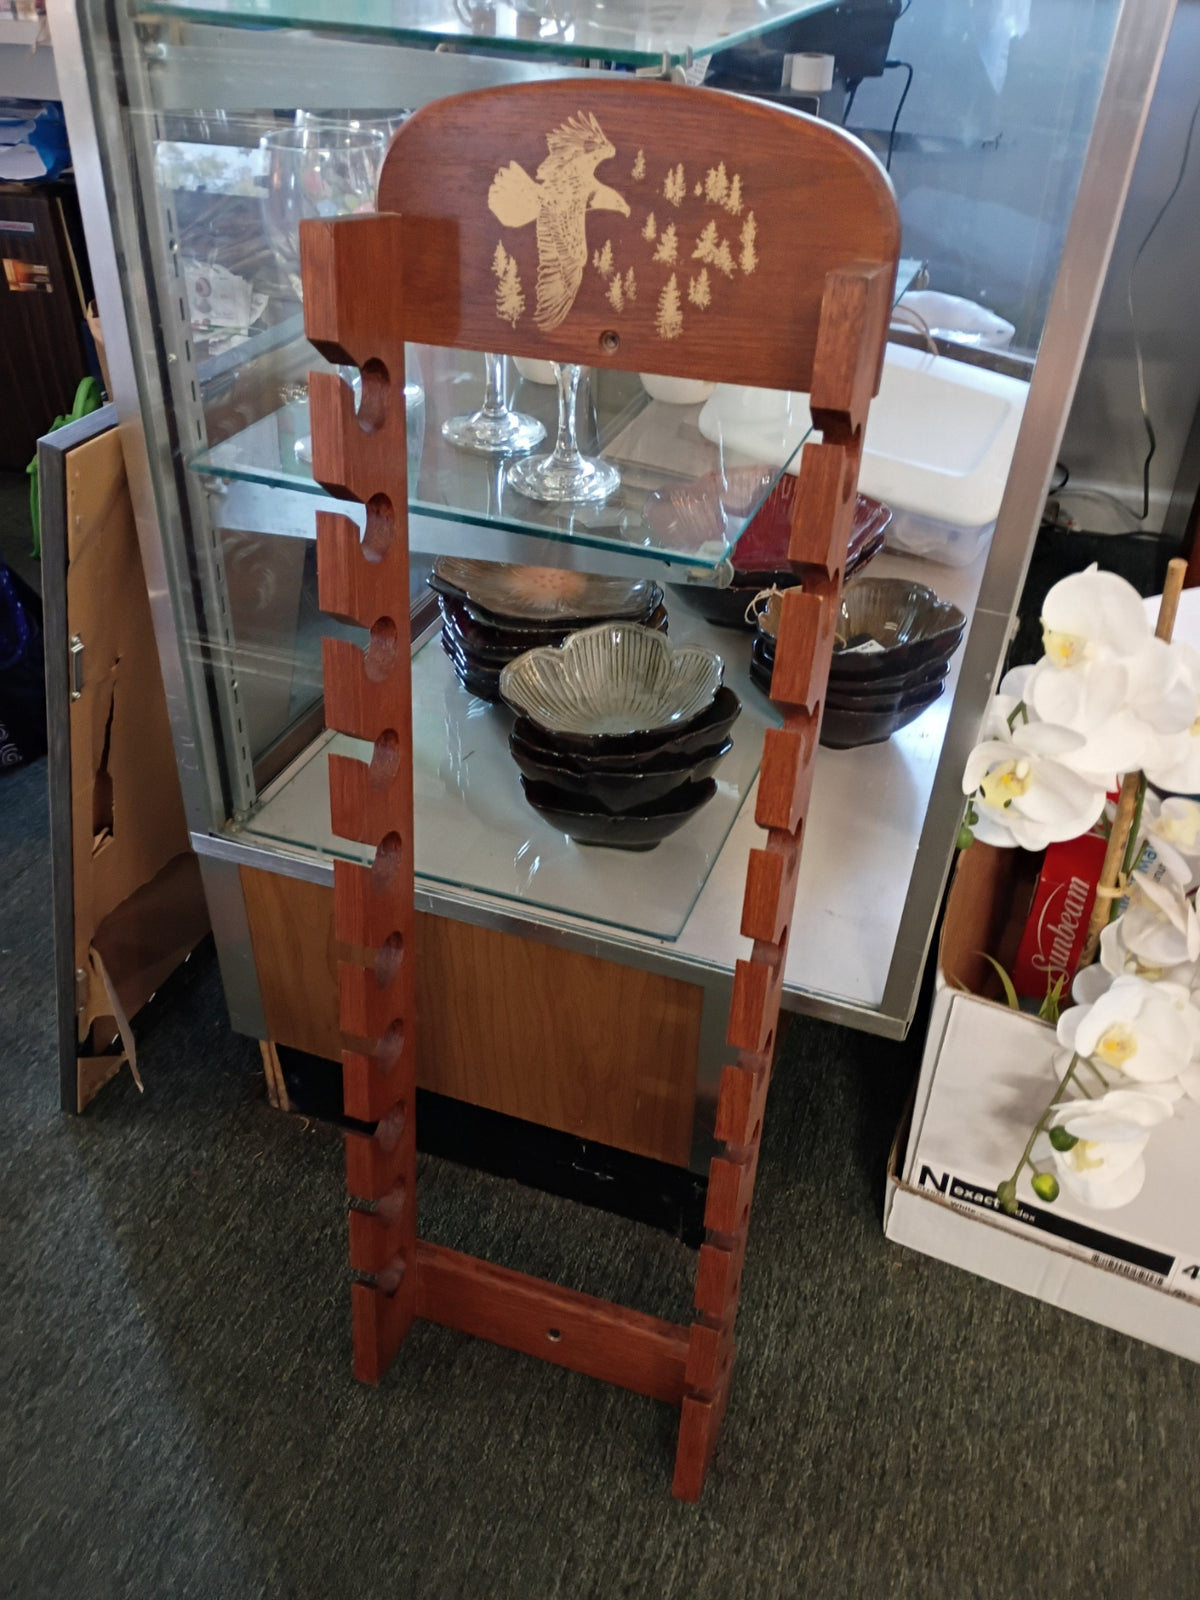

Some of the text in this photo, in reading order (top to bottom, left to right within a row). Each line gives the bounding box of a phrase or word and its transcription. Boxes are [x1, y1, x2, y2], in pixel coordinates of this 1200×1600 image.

[1031, 876, 1090, 985] Sunbeam
[919, 1165, 950, 1193] N
[954, 1186, 1000, 1209] exact
